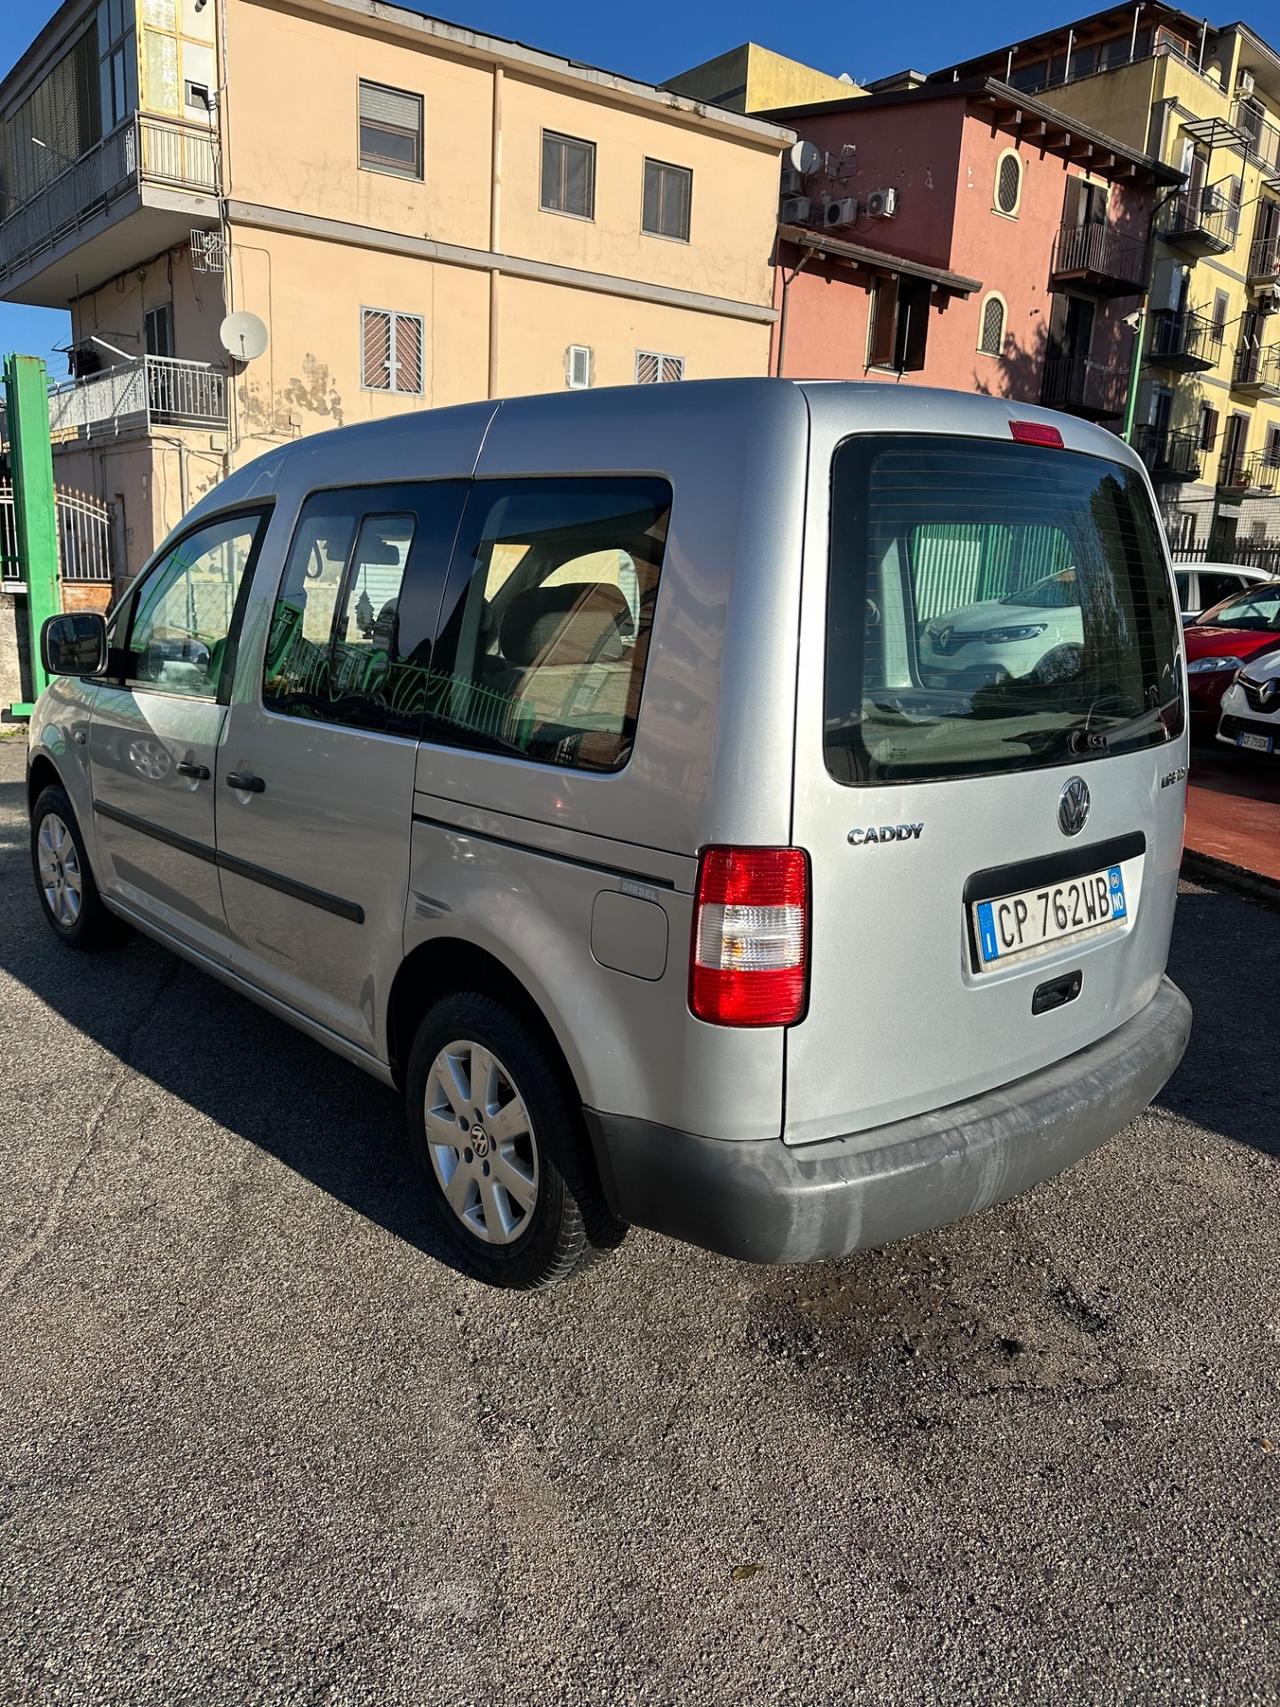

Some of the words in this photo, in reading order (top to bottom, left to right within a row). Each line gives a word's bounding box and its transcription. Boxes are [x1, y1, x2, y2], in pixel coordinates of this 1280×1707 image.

[847, 822, 924, 846] CADDY
[623, 881, 657, 901] DIESEL
[998, 899, 1028, 948] CP
[1037, 876, 1110, 937] 762WB
[1112, 892, 1124, 912] NO
[986, 933, 992, 953] I
